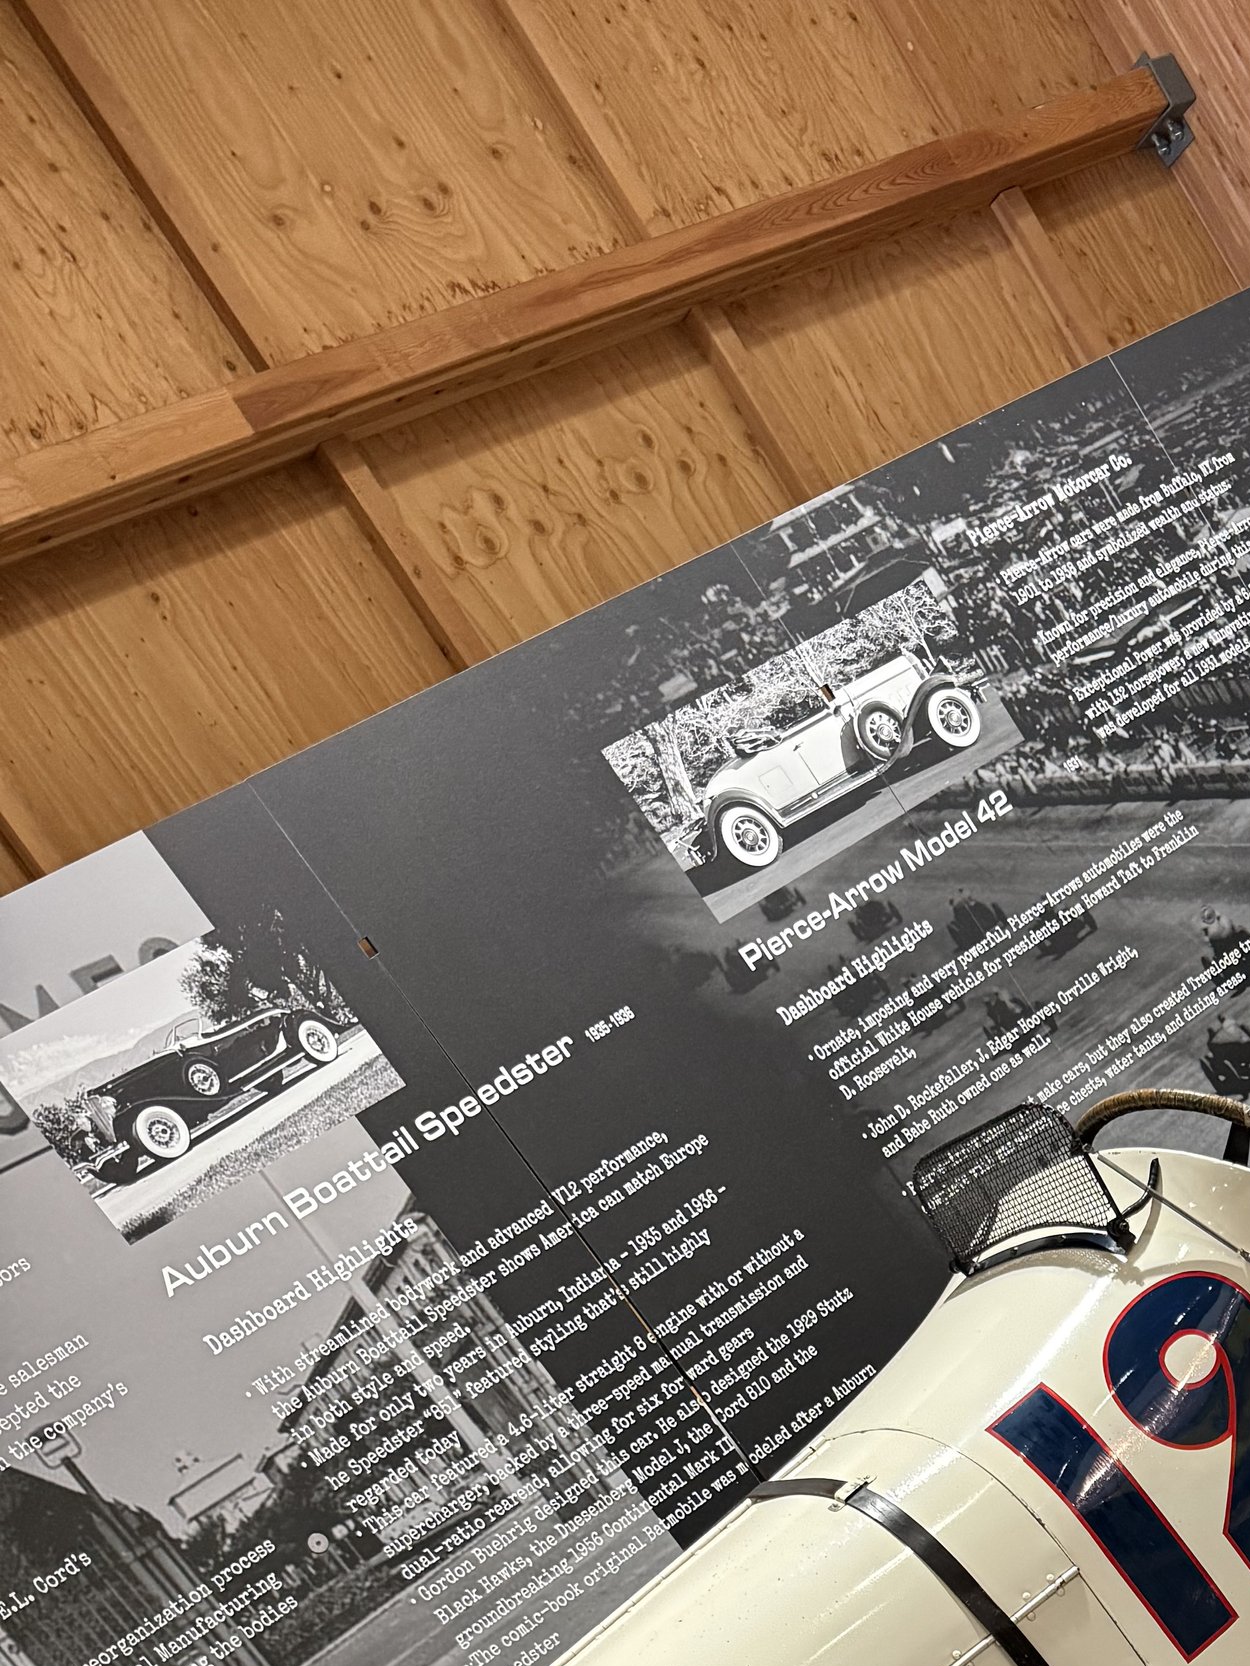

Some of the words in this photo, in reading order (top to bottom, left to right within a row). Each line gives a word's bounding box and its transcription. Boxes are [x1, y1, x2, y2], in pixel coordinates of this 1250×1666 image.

[738, 860, 903, 970] Pierce-Arrow
[900, 810, 977, 870] Model
[977, 789, 1012, 822] 42
[776, 966, 856, 1025] Dashboard
[851, 920, 932, 977] Highlights
[867, 1114, 898, 1137] John
[894, 1104, 910, 1119] D.
[907, 1059, 978, 1110] Rockefeller,
[976, 1048, 989, 1062] J.
[986, 1027, 1022, 1059] Edgar
[1017, 1001, 1060, 1033] Hoover,
[1057, 972, 1099, 1004] Orville
[1096, 946, 1138, 976] Wright,
[882, 1134, 905, 1157] and
[901, 1119, 930, 1142] Babe
[927, 1099, 958, 1124] Ruth
[957, 1073, 991, 1104] owned
[990, 1063, 1010, 1081] one
[1009, 1053, 1022, 1067] as
[1021, 1034, 1050, 1057] well.
[162, 1212, 287, 1296] Auburn
[283, 1126, 418, 1218] Boattail
[414, 1036, 572, 1140] Speedster
[202, 1281, 311, 1354] Dashboard
[306, 1213, 423, 1290] Highlights
[286, 1420, 314, 1450] in
[308, 1393, 352, 1434] both
[345, 1372, 393, 1404] style
[393, 1350, 423, 1376] and
[422, 1322, 475, 1358] speed.
[33, 1552, 92, 1594] Cord's
[153, 1572, 286, 1661] Manufacturing
[210, 1540, 274, 1591] process
